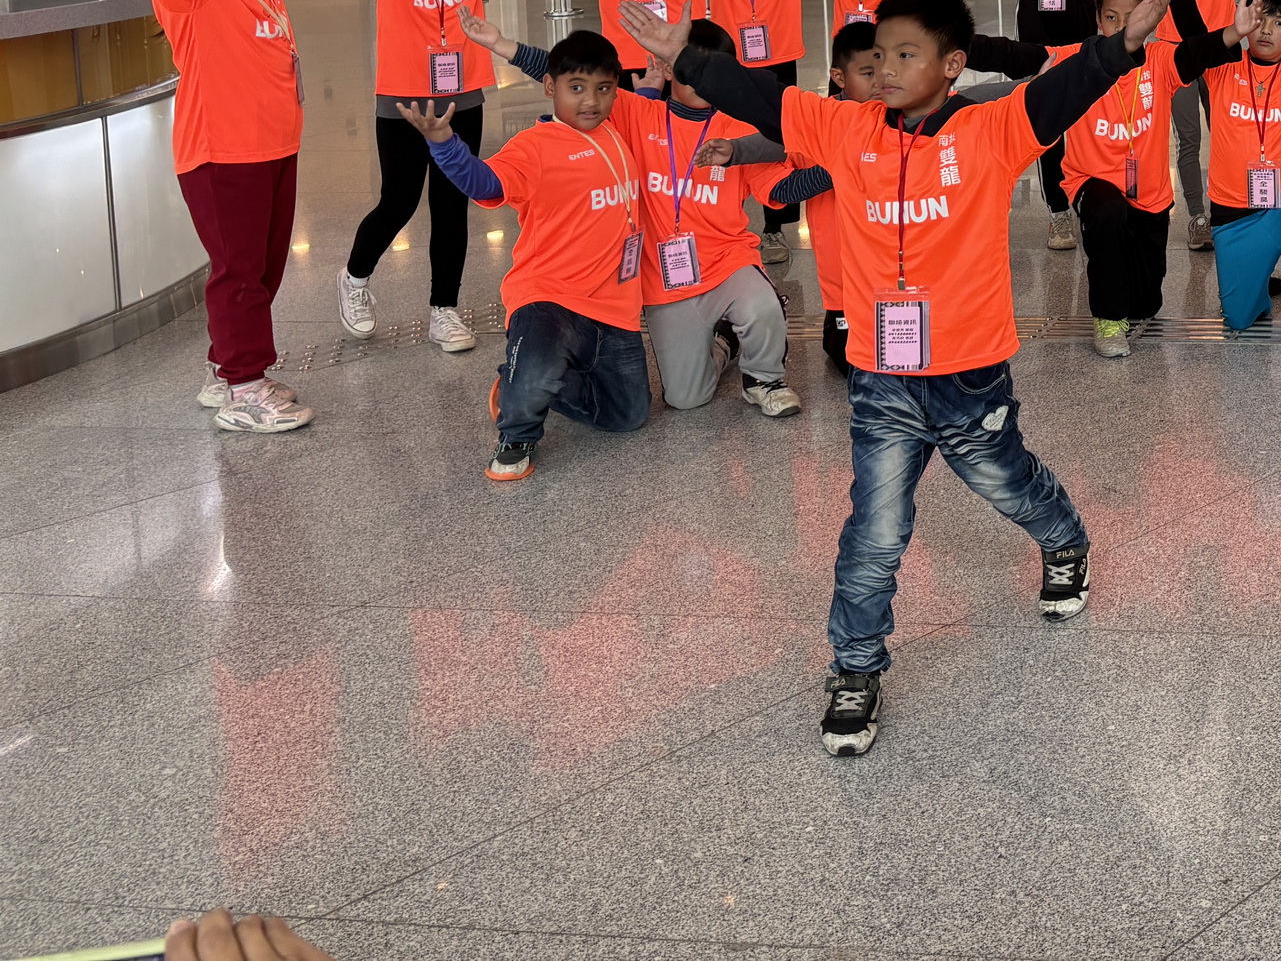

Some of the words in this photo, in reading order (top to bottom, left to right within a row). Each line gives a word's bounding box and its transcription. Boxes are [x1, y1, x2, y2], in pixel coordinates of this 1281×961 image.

[1095, 112, 1153, 141] BUNUN
[939, 146, 962, 188] 雙龍
[866, 195, 950, 225] BUNUN
